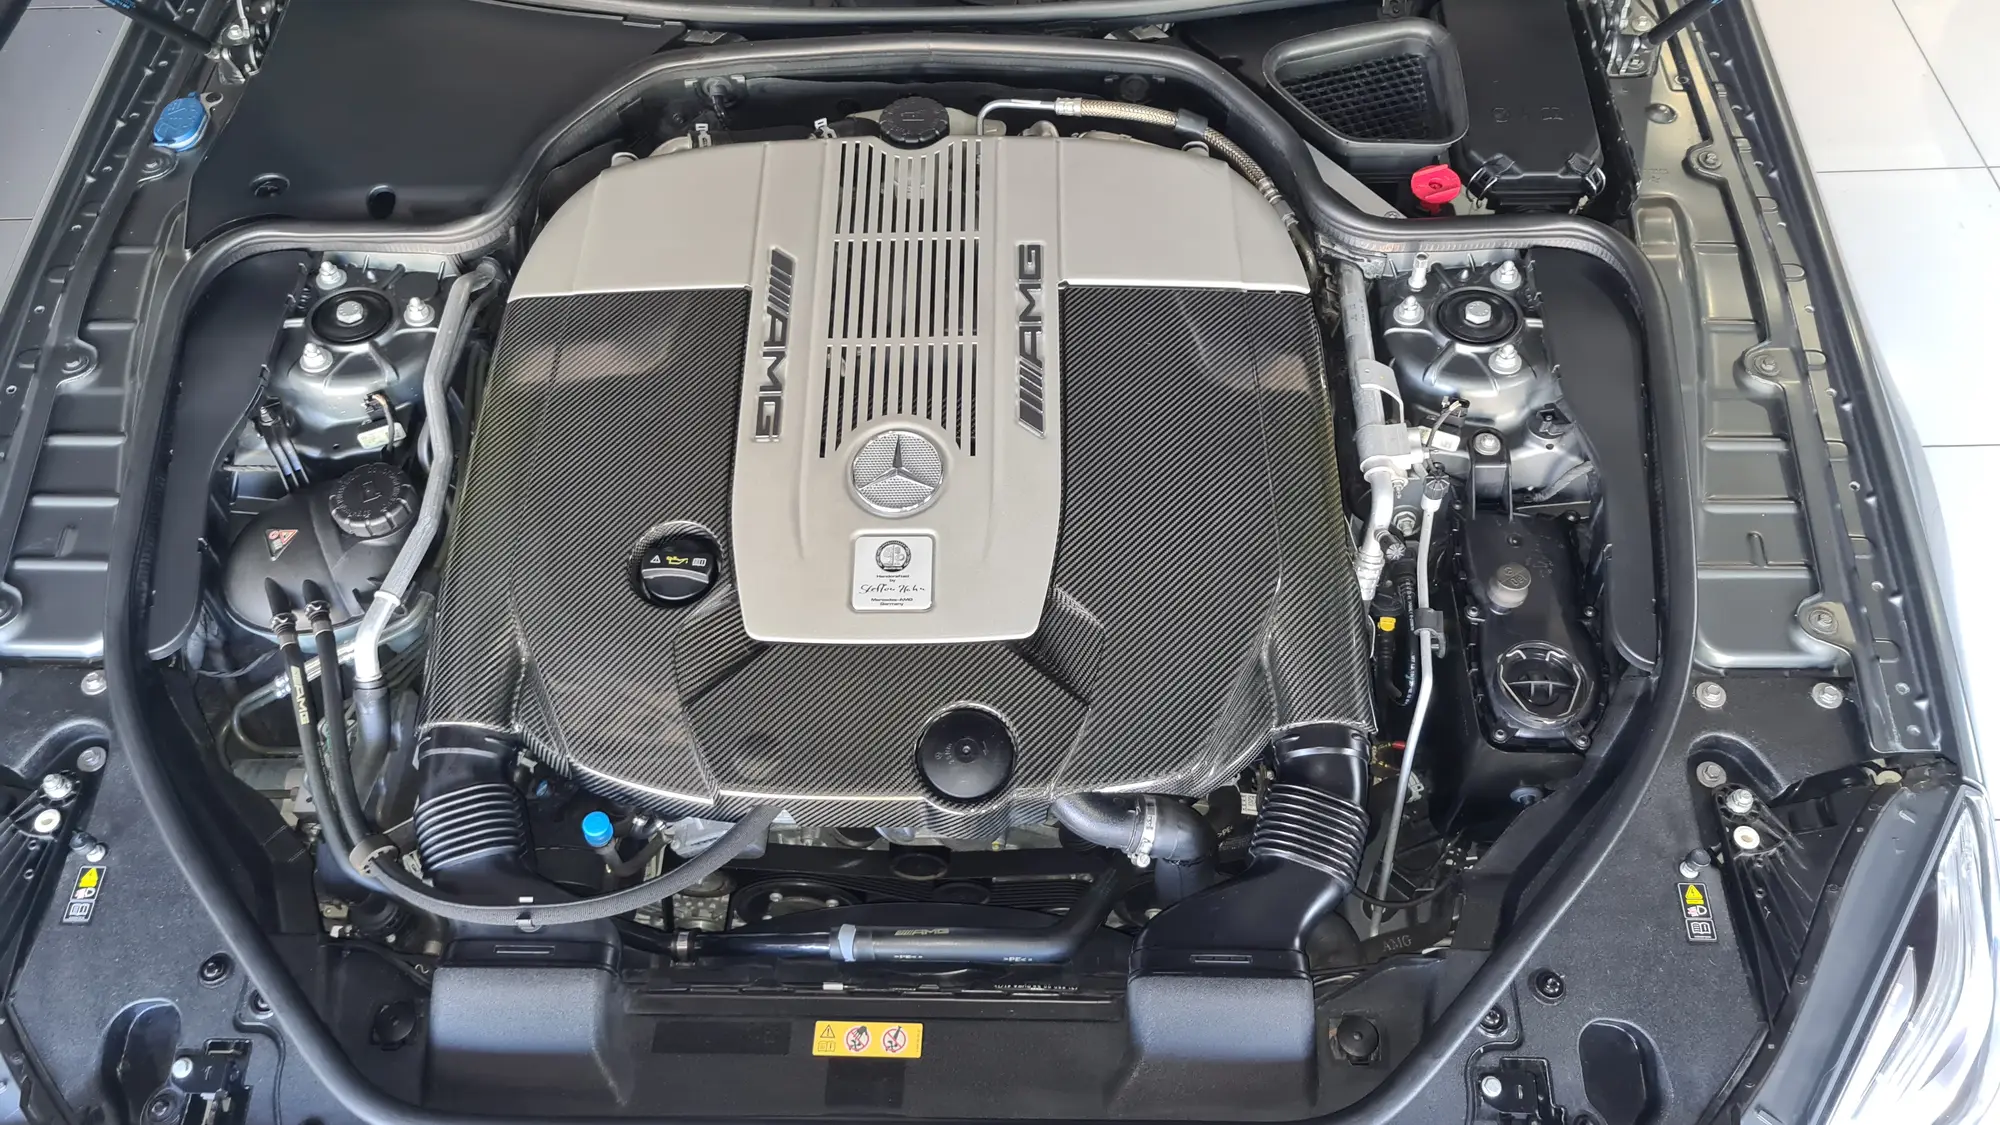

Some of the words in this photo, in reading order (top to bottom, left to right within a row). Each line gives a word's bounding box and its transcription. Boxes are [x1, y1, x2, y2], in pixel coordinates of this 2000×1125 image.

[1018, 244, 1043, 366] AMG
[755, 303, 788, 438] AMG
[1382, 934, 1412, 952] AMG
